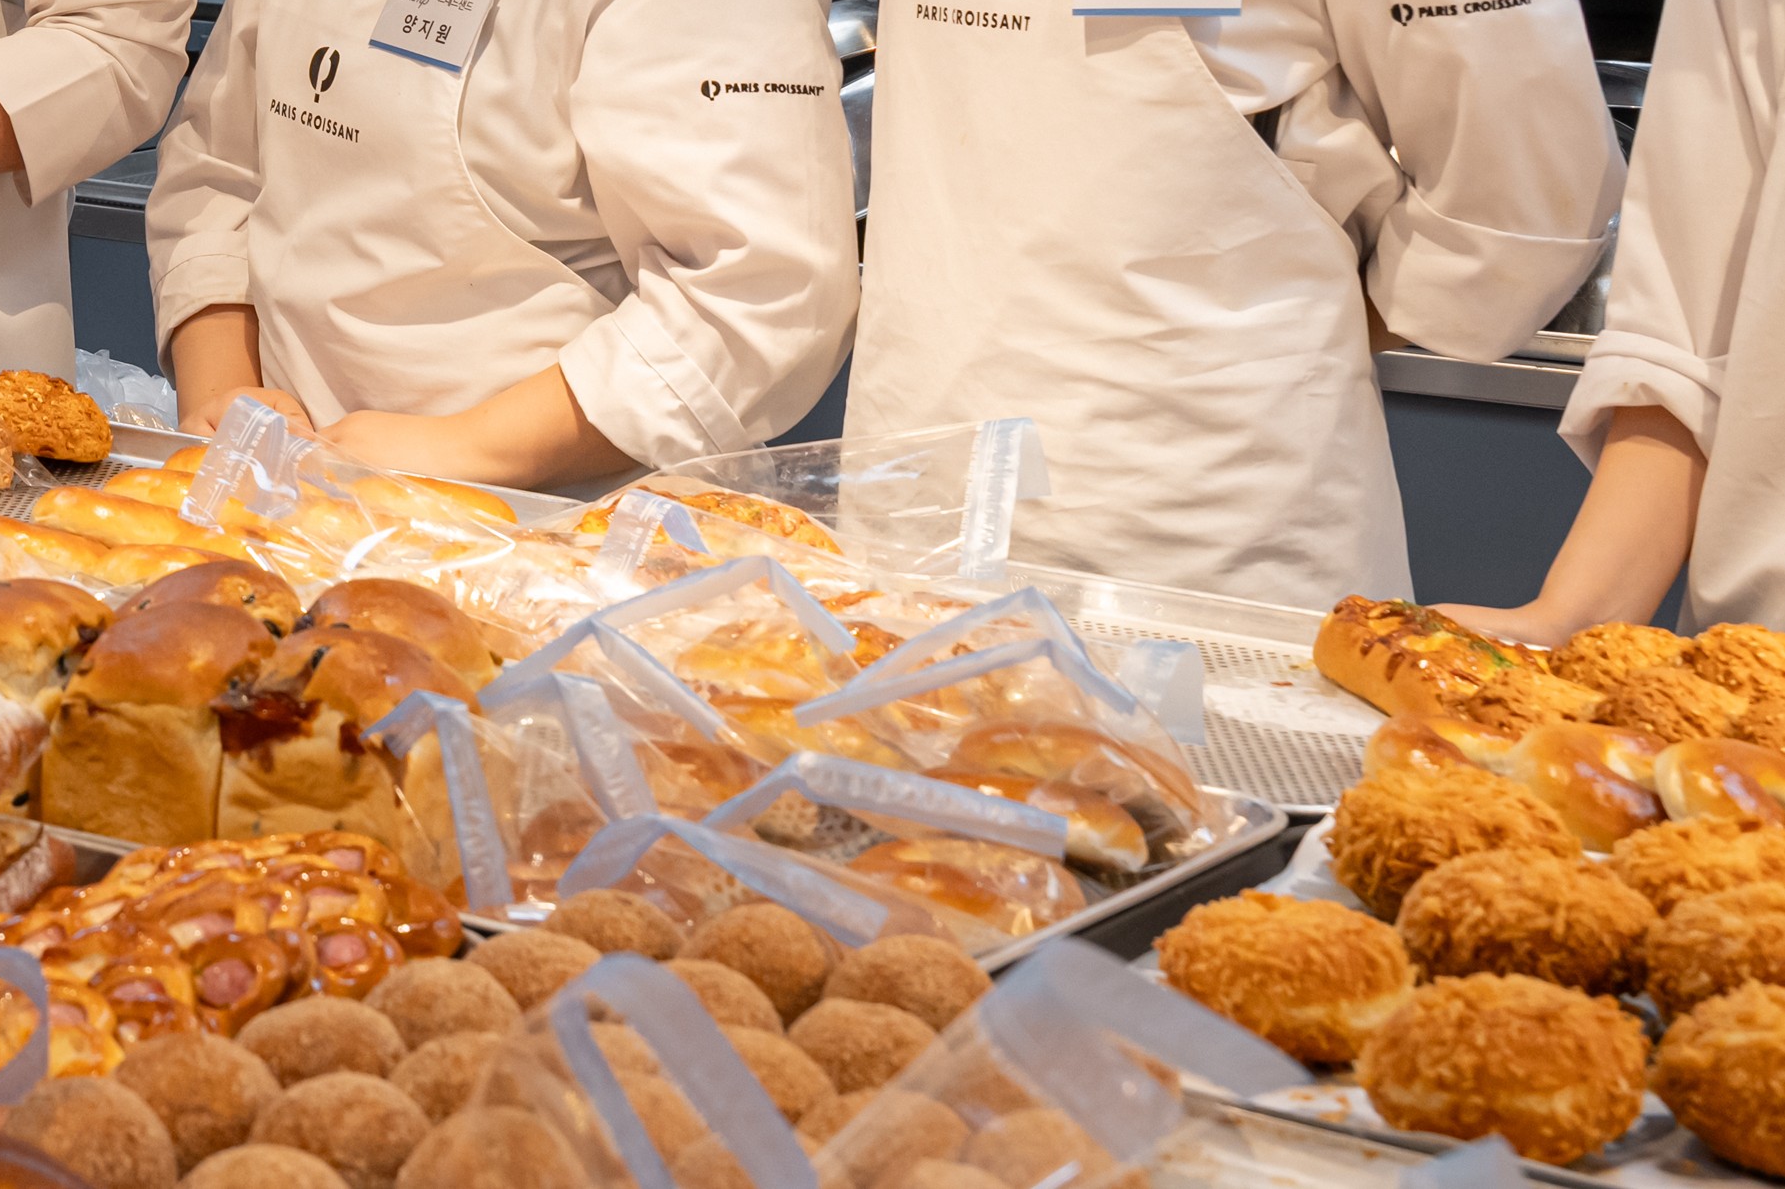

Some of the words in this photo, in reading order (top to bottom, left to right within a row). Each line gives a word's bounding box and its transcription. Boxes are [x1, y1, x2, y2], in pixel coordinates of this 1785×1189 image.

[916, 3, 948, 23] PARIS
[1418, 4, 1458, 18] PARIS
[402, 14, 452, 45] 양지원
[725, 82, 759, 93] PARIS
[764, 83, 822, 96] CROISSANT
[269, 98, 296, 121] PARIS
[300, 110, 360, 143] CROISSANT
